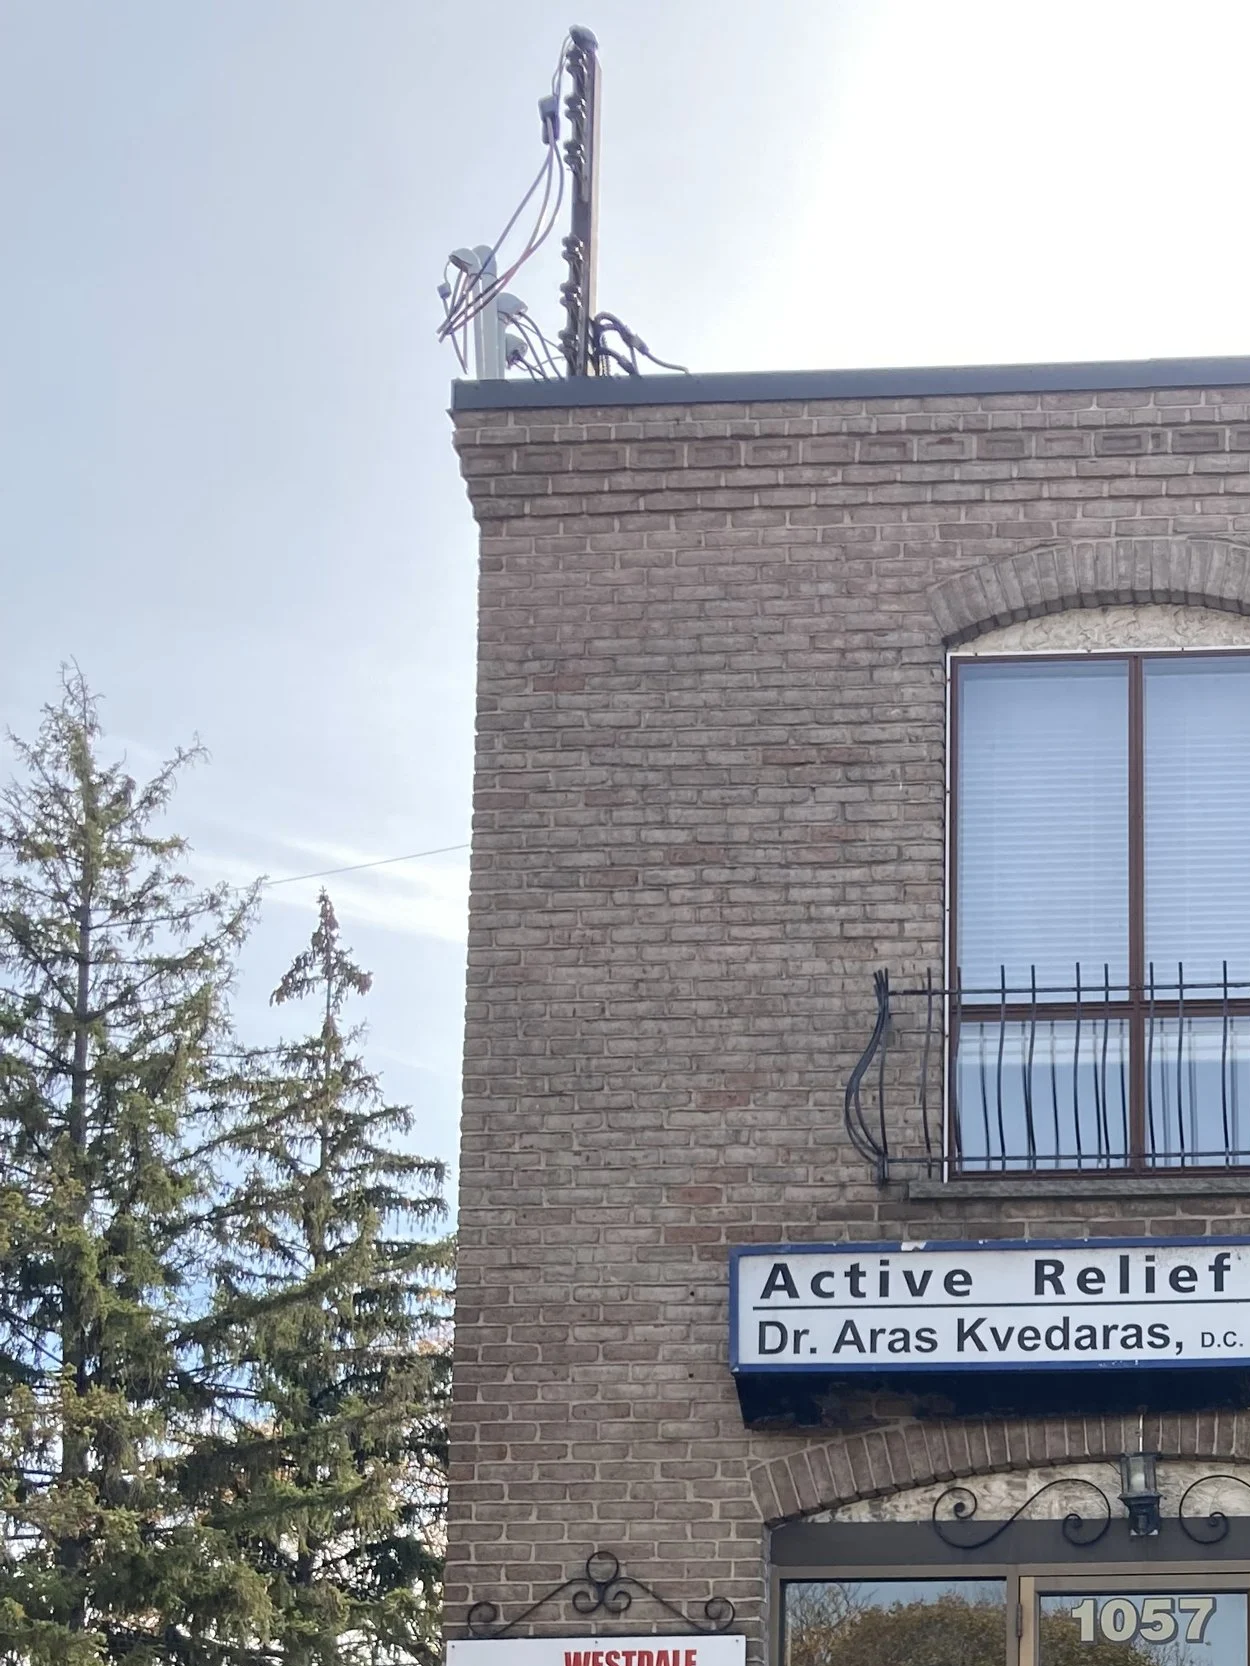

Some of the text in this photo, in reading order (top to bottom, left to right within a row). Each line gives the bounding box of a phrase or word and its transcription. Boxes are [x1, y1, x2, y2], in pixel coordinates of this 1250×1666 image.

[759, 1258, 973, 1300] Active
[1034, 1252, 1231, 1296] Relief
[758, 1316, 1244, 1355] Dr. Aras Kvedaras, D.C.
[1071, 1597, 1217, 1645] 1057
